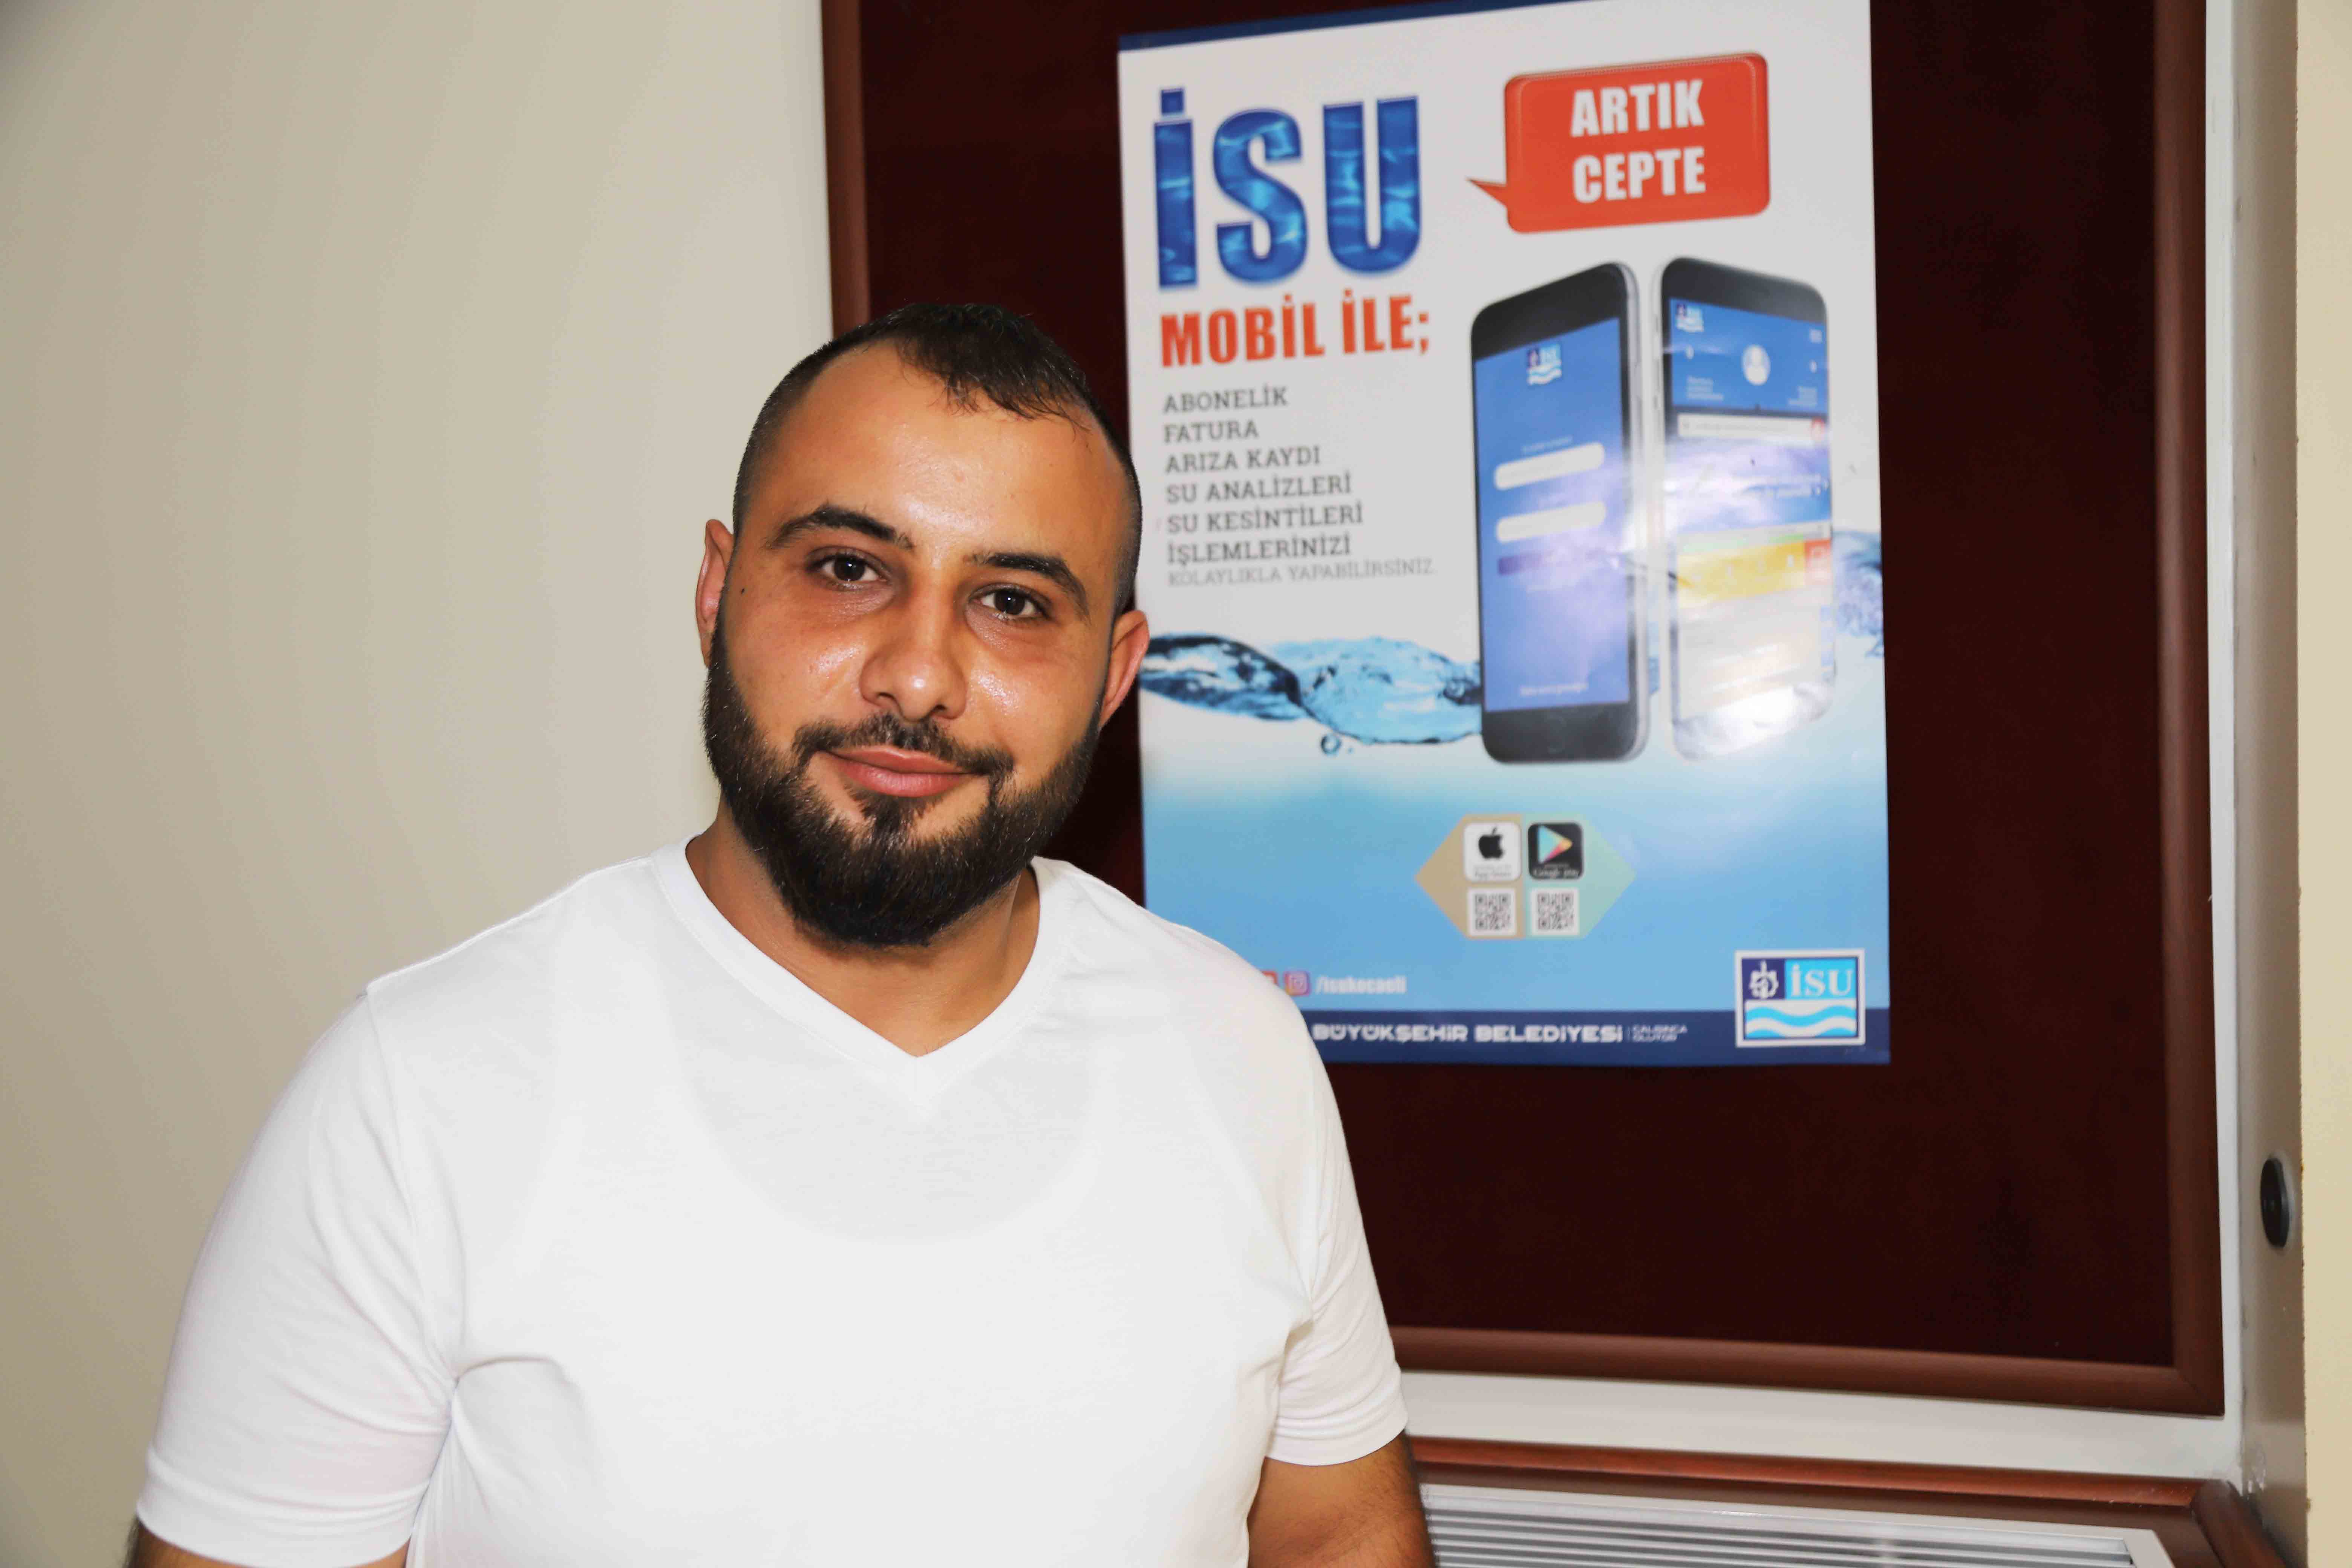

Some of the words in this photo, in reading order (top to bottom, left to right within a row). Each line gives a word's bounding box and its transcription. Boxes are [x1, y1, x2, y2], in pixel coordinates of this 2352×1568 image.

[1571, 78, 1705, 137] ARTIK
[1153, 87, 1420, 288] İSU
[1573, 146, 1706, 204] CEPTE
[1160, 294, 1325, 368] MOBİL
[1342, 289, 1429, 355] İLE;
[1163, 384, 1288, 414] ABONELİK
[1164, 419, 1259, 444] FATURA
[1165, 452, 1239, 473] ARIZA
[1247, 445, 1321, 469] KAYDI
[1167, 483, 1198, 504] SU
[1206, 470, 1352, 502] ANALİZLERİ
[1167, 514, 1199, 534] SU
[1207, 500, 1363, 531] KESİNTİLERİ
[1168, 531, 1351, 567] İŞLEMLERİNİZİ
[1168, 569, 1282, 586] KOLAYLIKLA
[1791, 963, 1854, 997] İSU
[1312, 1024, 1468, 1043] BÜYÜKŞEHİR
[1475, 1024, 1623, 1043] BELEDİYESİ
